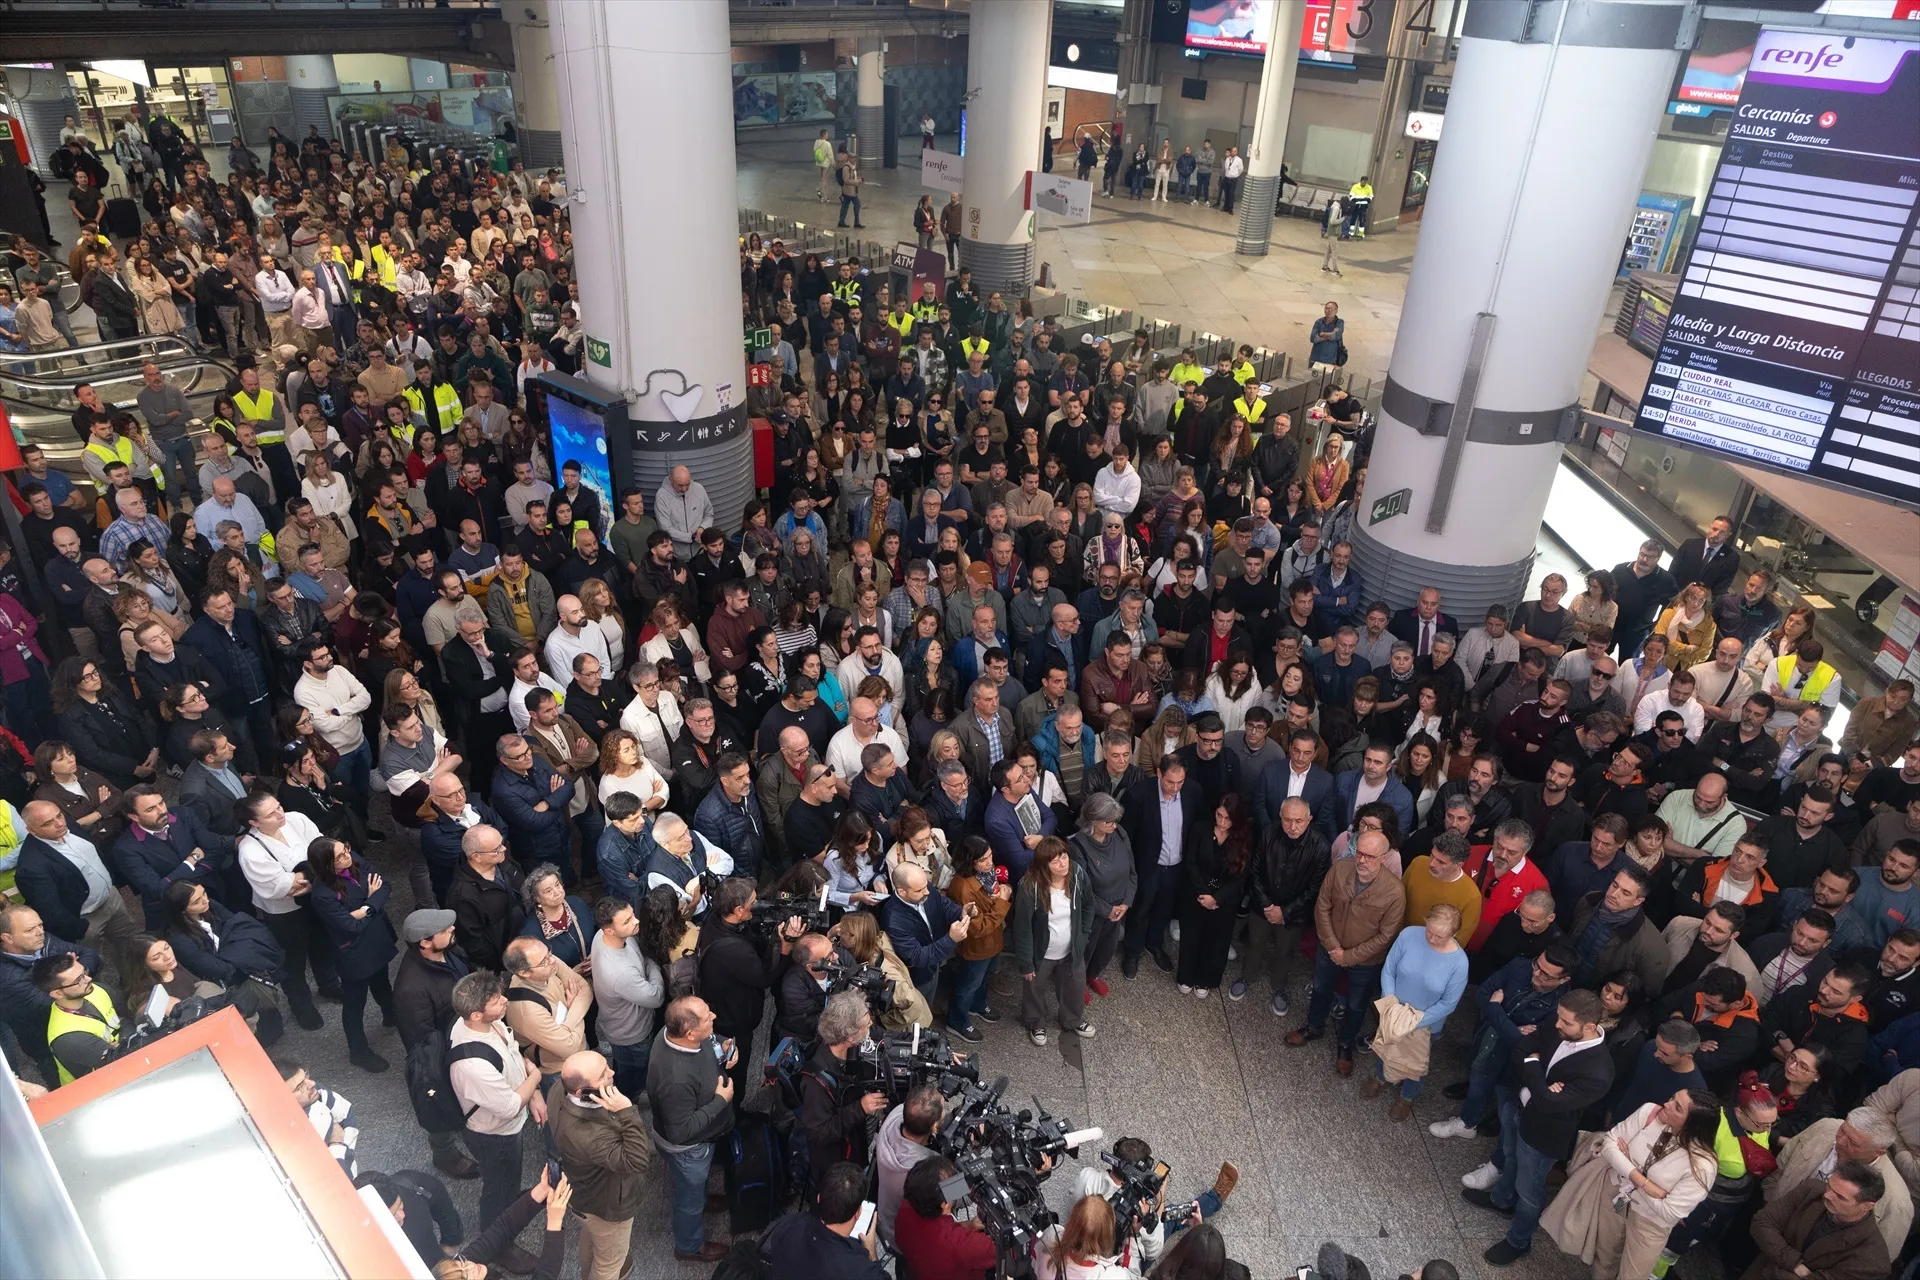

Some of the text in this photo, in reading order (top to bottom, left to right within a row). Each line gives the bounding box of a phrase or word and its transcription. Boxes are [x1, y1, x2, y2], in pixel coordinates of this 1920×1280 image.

[1345, 0, 1375, 40] 3
[1405, 0, 1437, 46] 4
[1185, 48, 1200, 57] global
[1761, 44, 1844, 74] renfe
[1675, 103, 1701, 115] global
[1739, 104, 1815, 125] Cercanías
[1733, 123, 1831, 145] SALIDAS Departures
[1762, 149, 1794, 160] Destino
[925, 160, 948, 173] renfe
[894, 254, 915, 269] ATM
[1667, 329, 1755, 356] SALIDAS Departures
[1670, 313, 1845, 361] Media y Larga Distancia
[1662, 345, 1680, 356] Hora
[1689, 351, 1718, 365] Destino
[1687, 359, 1718, 371] Destination
[1656, 364, 1733, 388] 13:11 CIUDAD REAL
[1856, 369, 1913, 390] LLEGADAS
[1649, 386, 1713, 408] 14:37 ALBACETE
[1849, 387, 1870, 399] Hora
[1642, 408, 1665, 419] 14:50
[1667, 414, 1697, 428] MERIDA
[1735, 396, 1773, 411] ALCAZAR,
[1775, 405, 1797, 416] Cinco
[1799, 411, 1823, 424] Casas,
[1893, 405, 1910, 416] from
[1718, 415, 1769, 435] Villarrobledo,
[1771, 429, 1782, 438] LA
[1784, 432, 1809, 446] RODA,
[1671, 427, 1718, 447] Fuenlabrada,
[1720, 440, 1750, 455] Illescas,
[1752, 448, 1783, 463] Torrijos,
